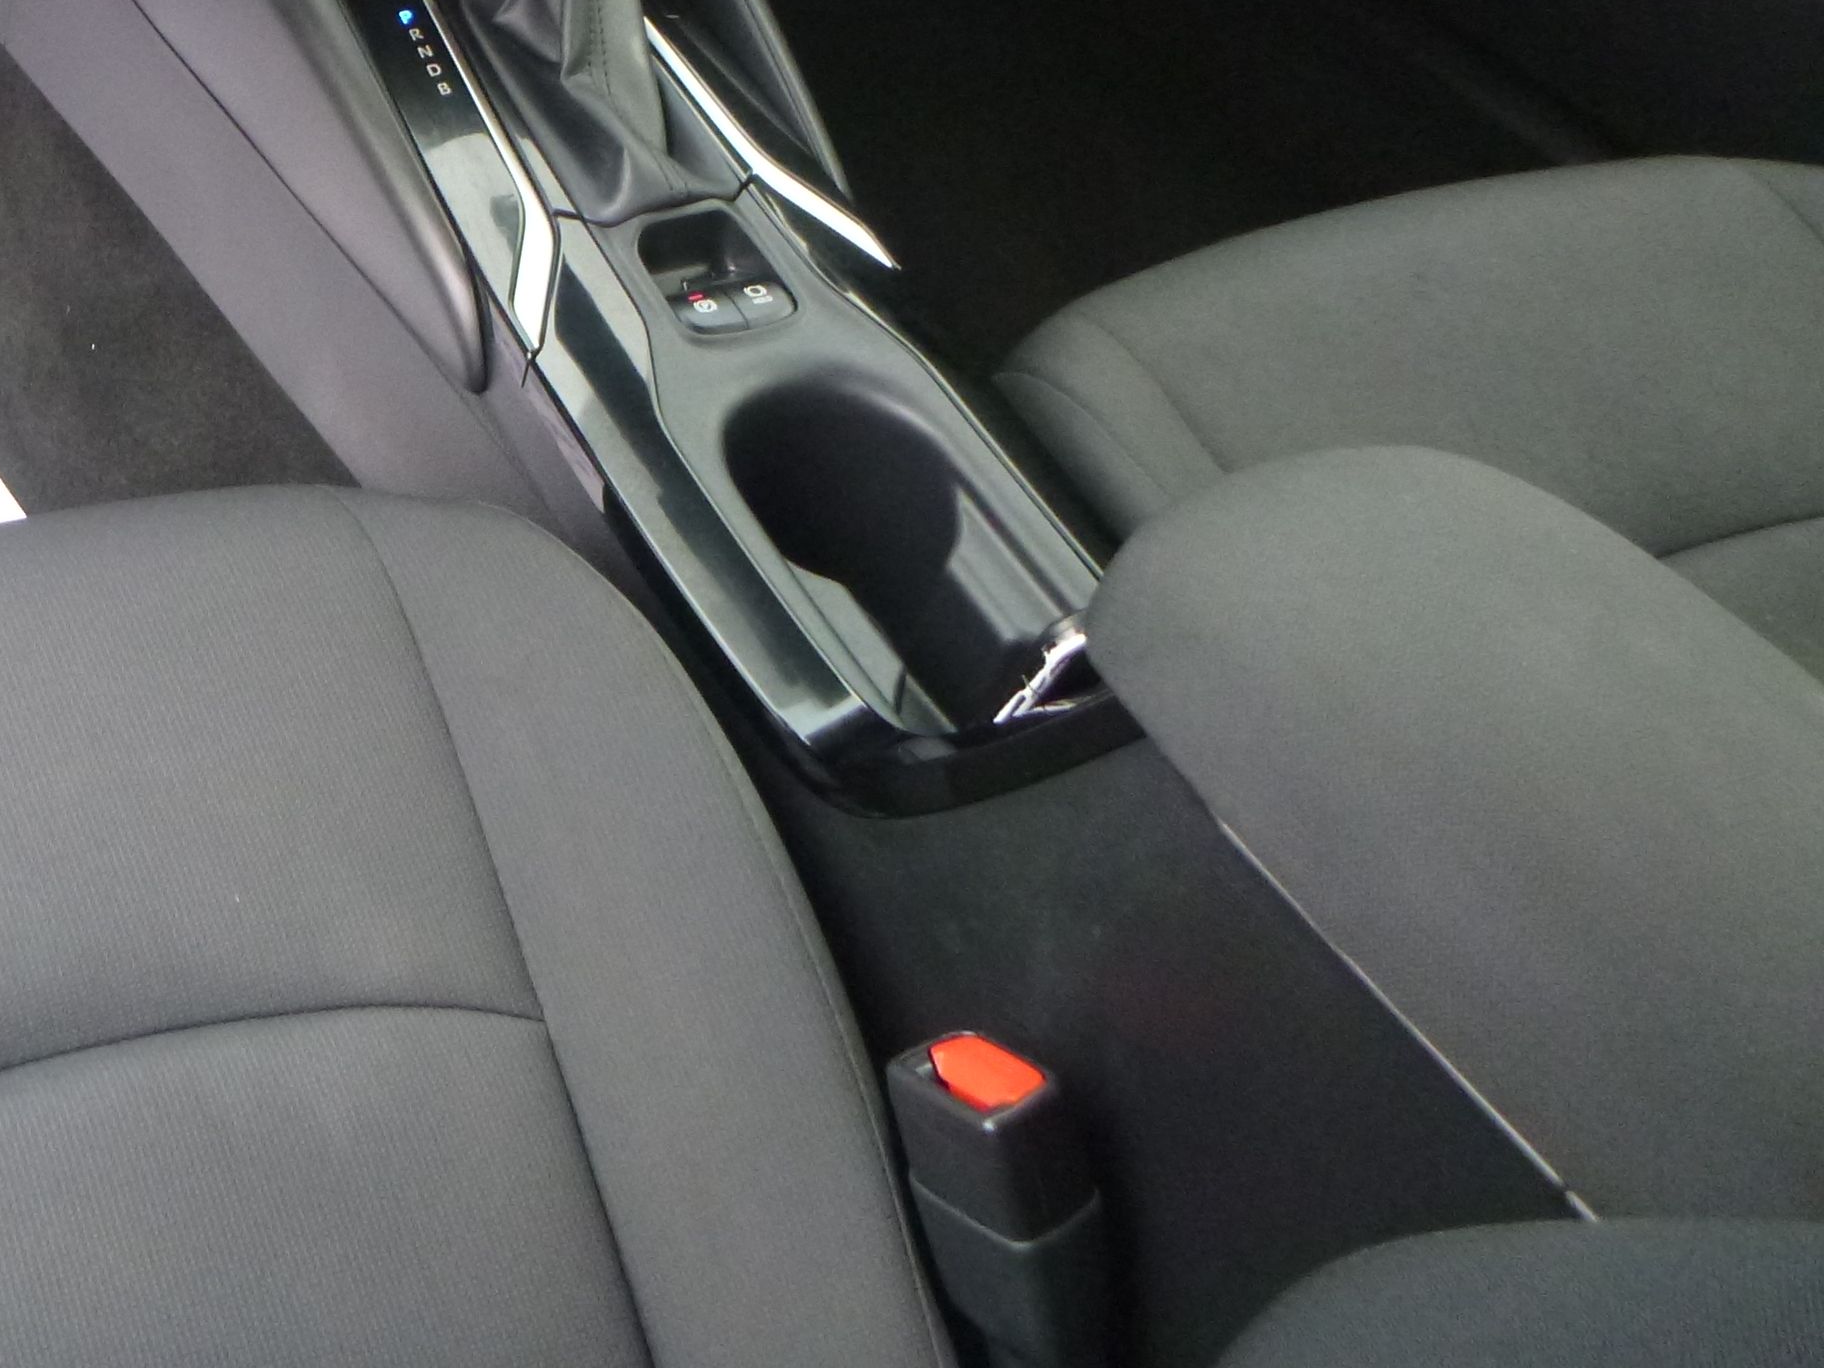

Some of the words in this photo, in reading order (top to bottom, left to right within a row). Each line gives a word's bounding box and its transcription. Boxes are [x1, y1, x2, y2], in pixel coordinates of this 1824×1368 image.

[398, 10, 414, 25] P
[409, 28, 424, 42] R
[417, 45, 434, 59] N
[426, 62, 442, 77] D
